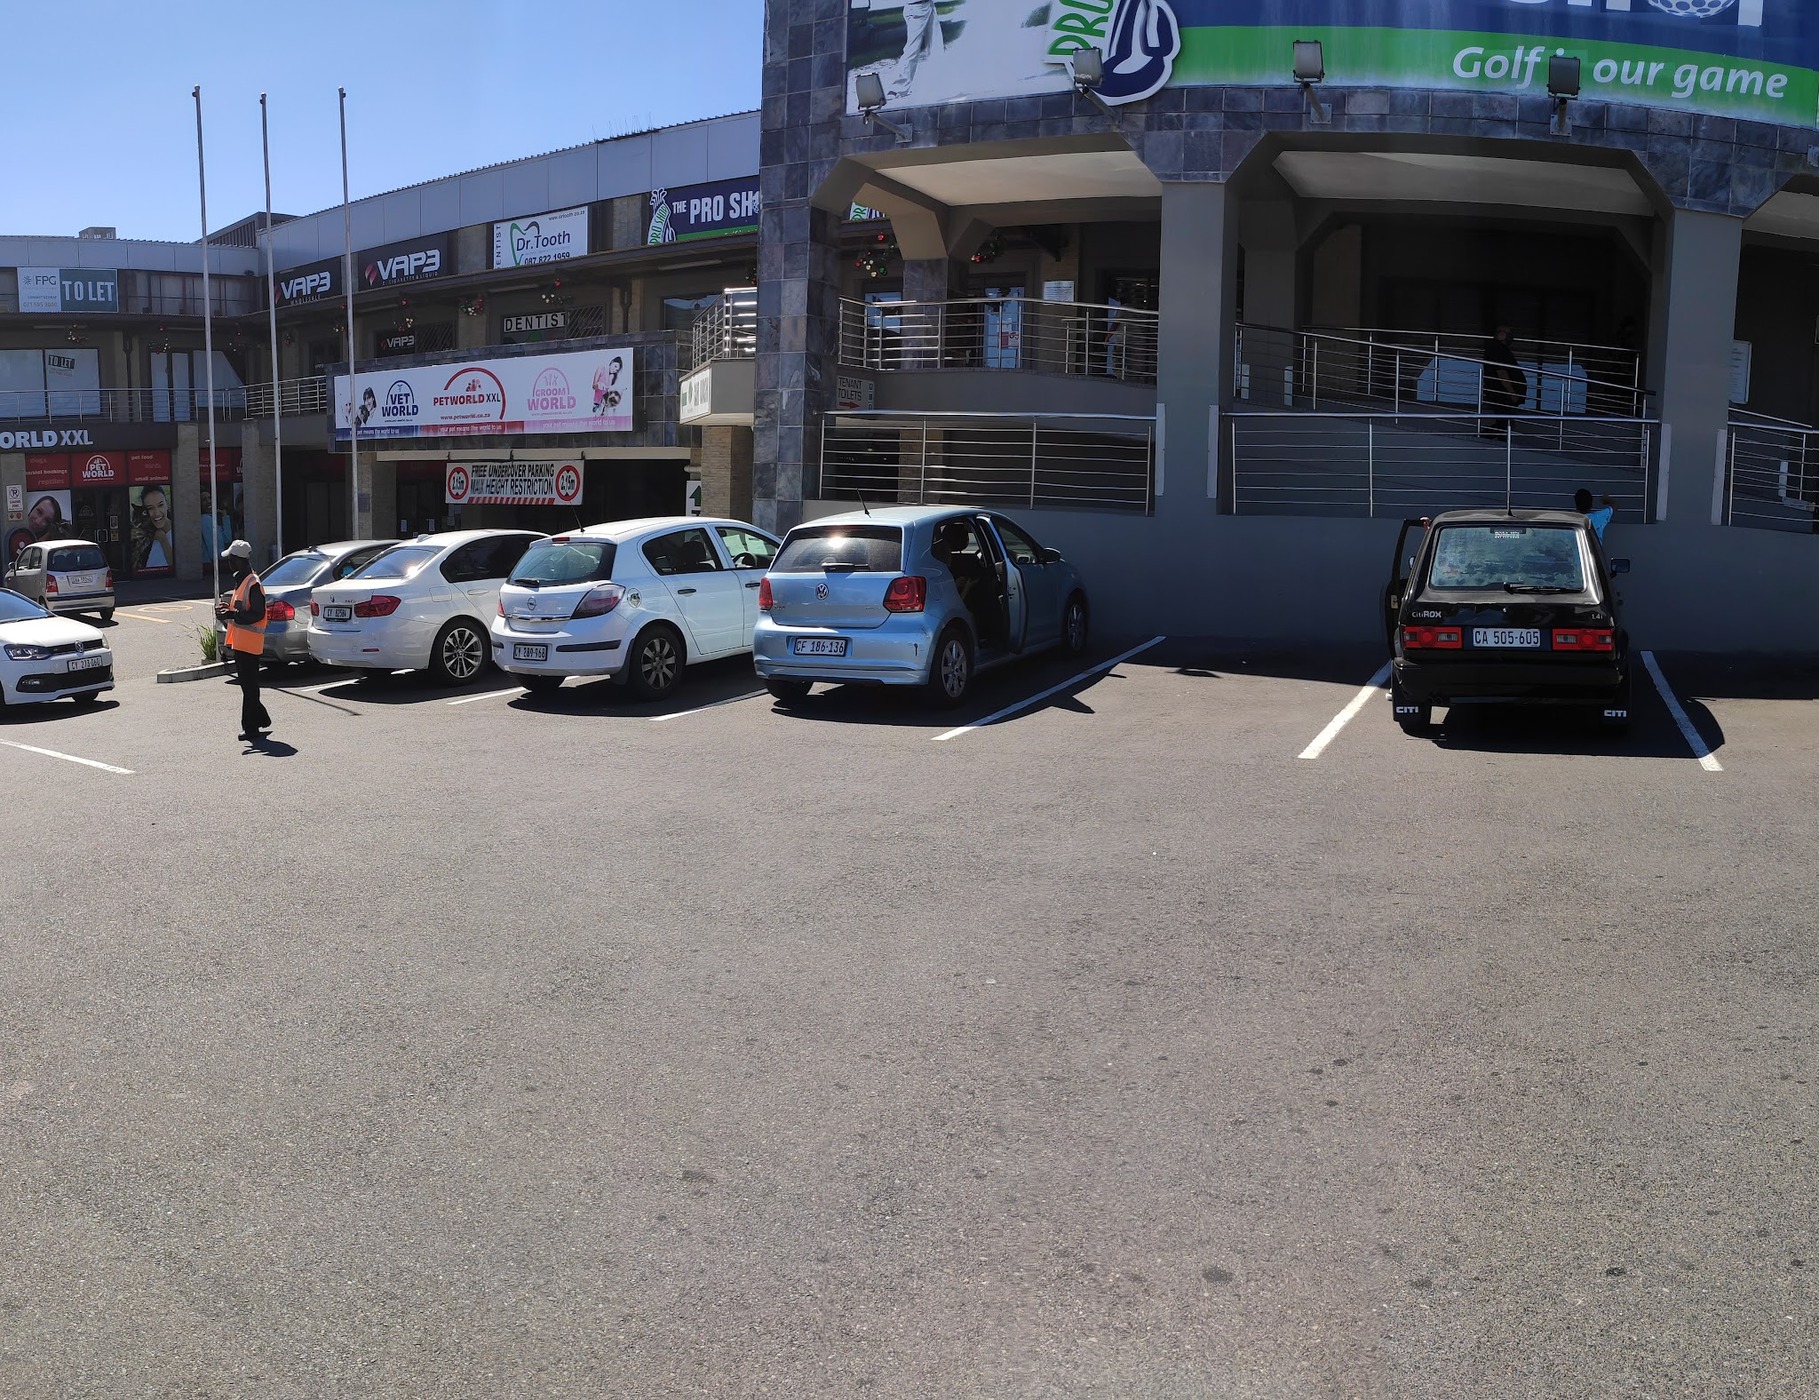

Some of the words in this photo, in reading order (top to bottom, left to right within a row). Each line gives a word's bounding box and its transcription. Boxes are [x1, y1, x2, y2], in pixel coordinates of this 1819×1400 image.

[1452, 46, 1546, 90] Golf
[1593, 58, 1664, 86] our
[1671, 63, 1788, 99] game
[672, 201, 687, 214] THE
[690, 195, 725, 224] PRO
[729, 190, 760, 219] SHO
[35, 275, 57, 286] FPG
[62, 281, 84, 301] TO
[88, 281, 114, 302] LET
[838, 376, 863, 390] TENANT
[486, 393, 501, 403] XXL
[535, 387, 566, 397] GROOM
[390, 393, 410, 405] VET
[527, 396, 577, 411] WORLD
[382, 405, 419, 417] WORLD
[0, 430, 58, 448] ORLD
[60, 430, 94, 446] XXL
[89, 463, 106, 471] PET
[471, 465, 488, 478] FREE
[488, 464, 526, 478] UNDERCOVER
[527, 463, 555, 478] PARKING
[82, 470, 115, 478] WORLD
[485, 478, 508, 495] HEIGHT
[511, 478, 554, 495] RESTRICTION
[1474, 632, 1489, 645] CA
[1493, 632, 1540, 645] 505-605
[796, 640, 807, 652] CF
[810, 641, 844, 653] 186-136
[1396, 706, 1419, 714] CITI
[1604, 709, 1627, 718] CITI
